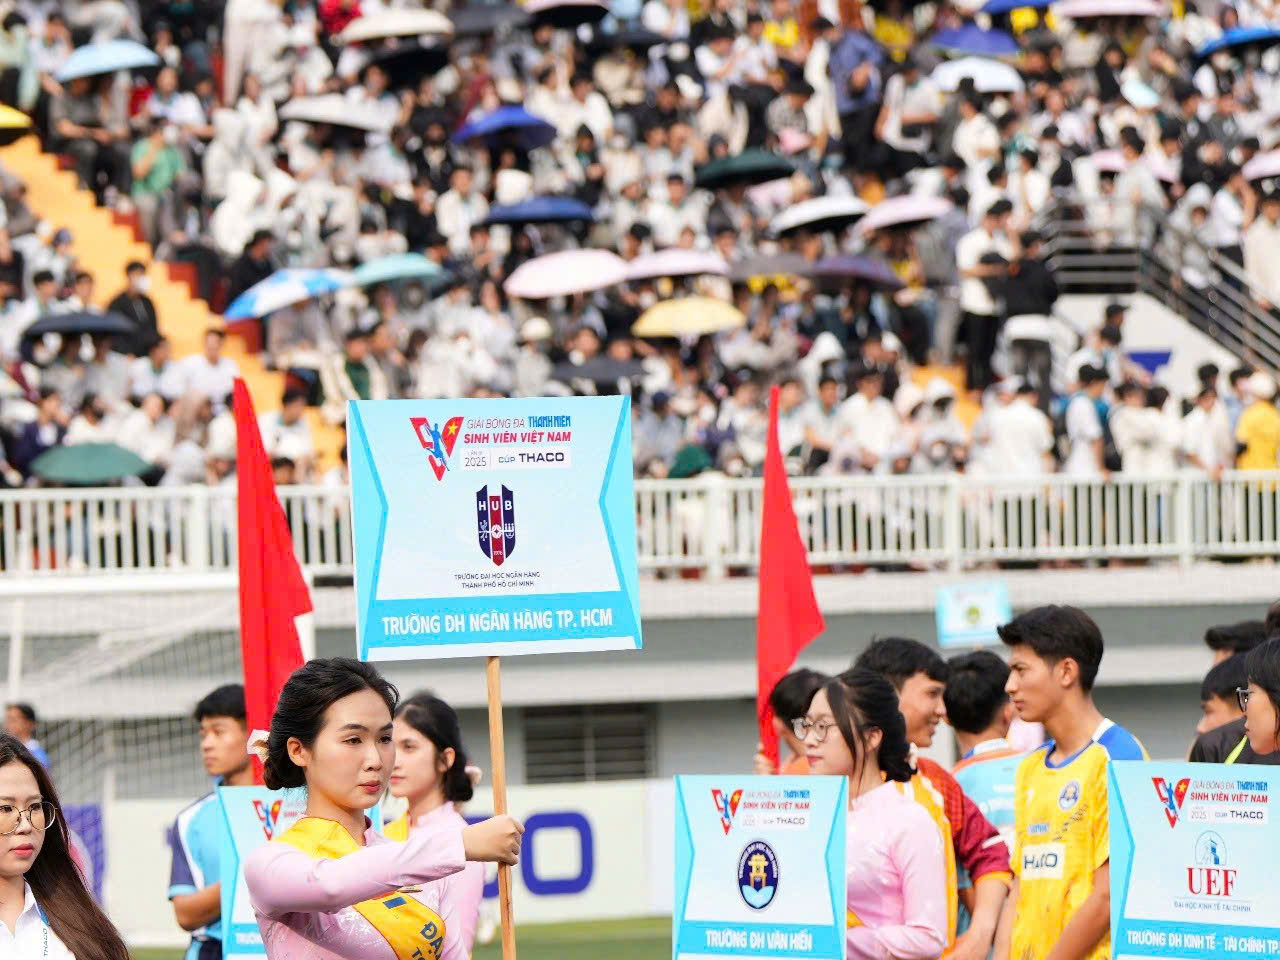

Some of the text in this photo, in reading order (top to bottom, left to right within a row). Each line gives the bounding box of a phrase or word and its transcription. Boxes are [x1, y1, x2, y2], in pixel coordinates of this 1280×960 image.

[464, 430, 571, 444] SINH VIÊN VIỆT NAM
[465, 457, 487, 467] 2025
[519, 452, 565, 462] THACO
[382, 608, 613, 636] TRƯỜNG ĐH NGÂN HÀNG TP. HCM
[1212, 792, 1229, 801] VIÊN
[1232, 793, 1248, 802] VIỆT
[1251, 794, 1268, 803] NAM
[1230, 810, 1263, 819] THACO
[776, 817, 805, 825] THACO
[1186, 867, 1237, 896] UEF
[1168, 932, 1181, 947] ĐH
[1184, 934, 1203, 949] KINH
[1239, 937, 1266, 952] CHÍNH
